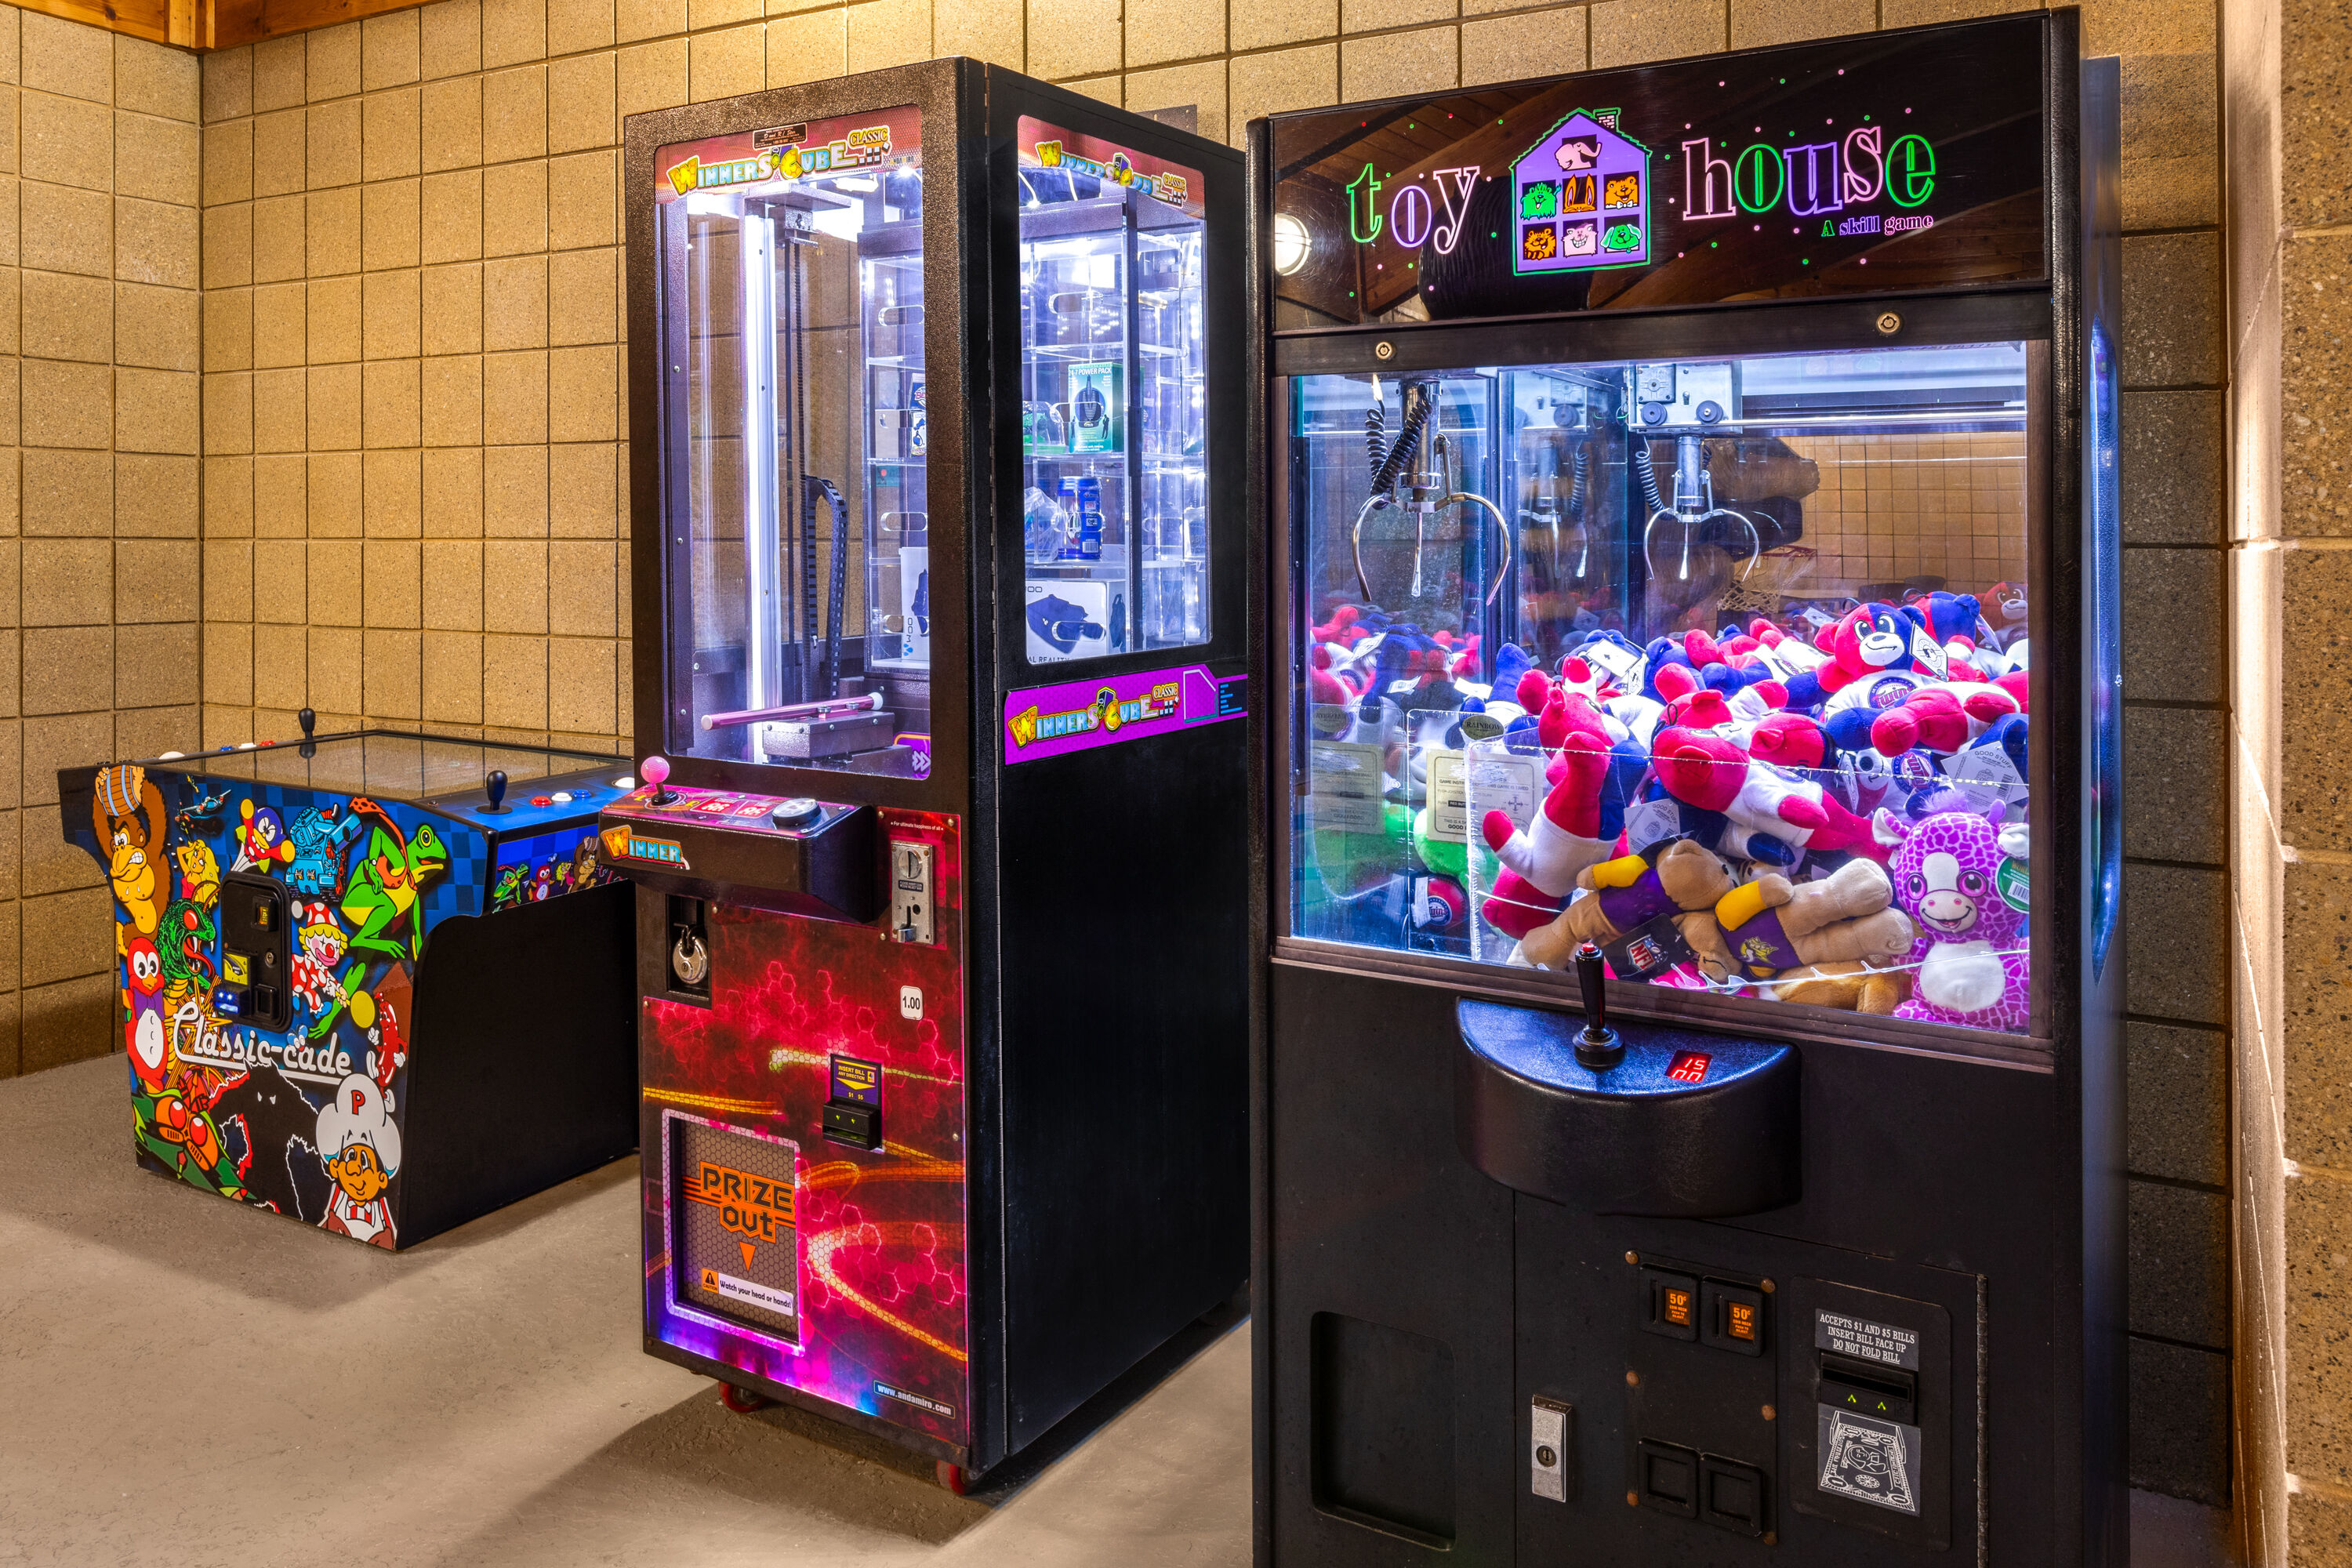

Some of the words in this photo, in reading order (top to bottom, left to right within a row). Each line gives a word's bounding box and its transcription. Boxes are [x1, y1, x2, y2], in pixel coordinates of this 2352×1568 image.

[850, 128, 888, 147] CLASSIC
[1163, 174, 1185, 191] CLASSIC
[1682, 126, 1936, 220] house
[1346, 163, 1480, 254] toy
[1821, 220, 1835, 237] A
[1839, 215, 1881, 236] skill
[1884, 215, 1933, 236] game
[1152, 683, 1178, 699] CLASSIC
[1105, 695, 1159, 731] CUBE
[1466, 721, 1501, 730] RAINBOW
[1994, 754, 2013, 768] STUFF
[1667, 810, 1678, 824] STUFF
[604, 828, 681, 862] WINNER
[1631, 942, 1655, 970] NFL
[902, 996, 920, 1010] 1.00
[172, 1000, 352, 1082] Classic-cade
[1685, 1058, 1706, 1070] 15
[351, 1090, 365, 1116] P
[703, 1167, 793, 1213] PRIZE
[720, 1279, 737, 1292] Watch
[752, 1290, 765, 1301] head
[773, 1297, 792, 1308] hands!
[1820, 1313, 1852, 1329] ACCEPTS
[1853, 1321, 1862, 1331] $1
[1864, 1324, 1880, 1335] AND
[1882, 1328, 1890, 1338] $5
[1893, 1330, 1915, 1344] BILLS
[1828, 1326, 1855, 1341] INSERT
[1857, 1333, 1874, 1345] BILL
[1875, 1338, 1894, 1350] FACE
[1896, 1342, 1907, 1352] UP
[1833, 1338, 1843, 1349] DO
[1845, 1341, 1860, 1353] NOT
[1861, 1345, 1881, 1359] FOLD
[1882, 1350, 1900, 1363] BILL
[877, 1385, 952, 1415] www.andamiro.com
